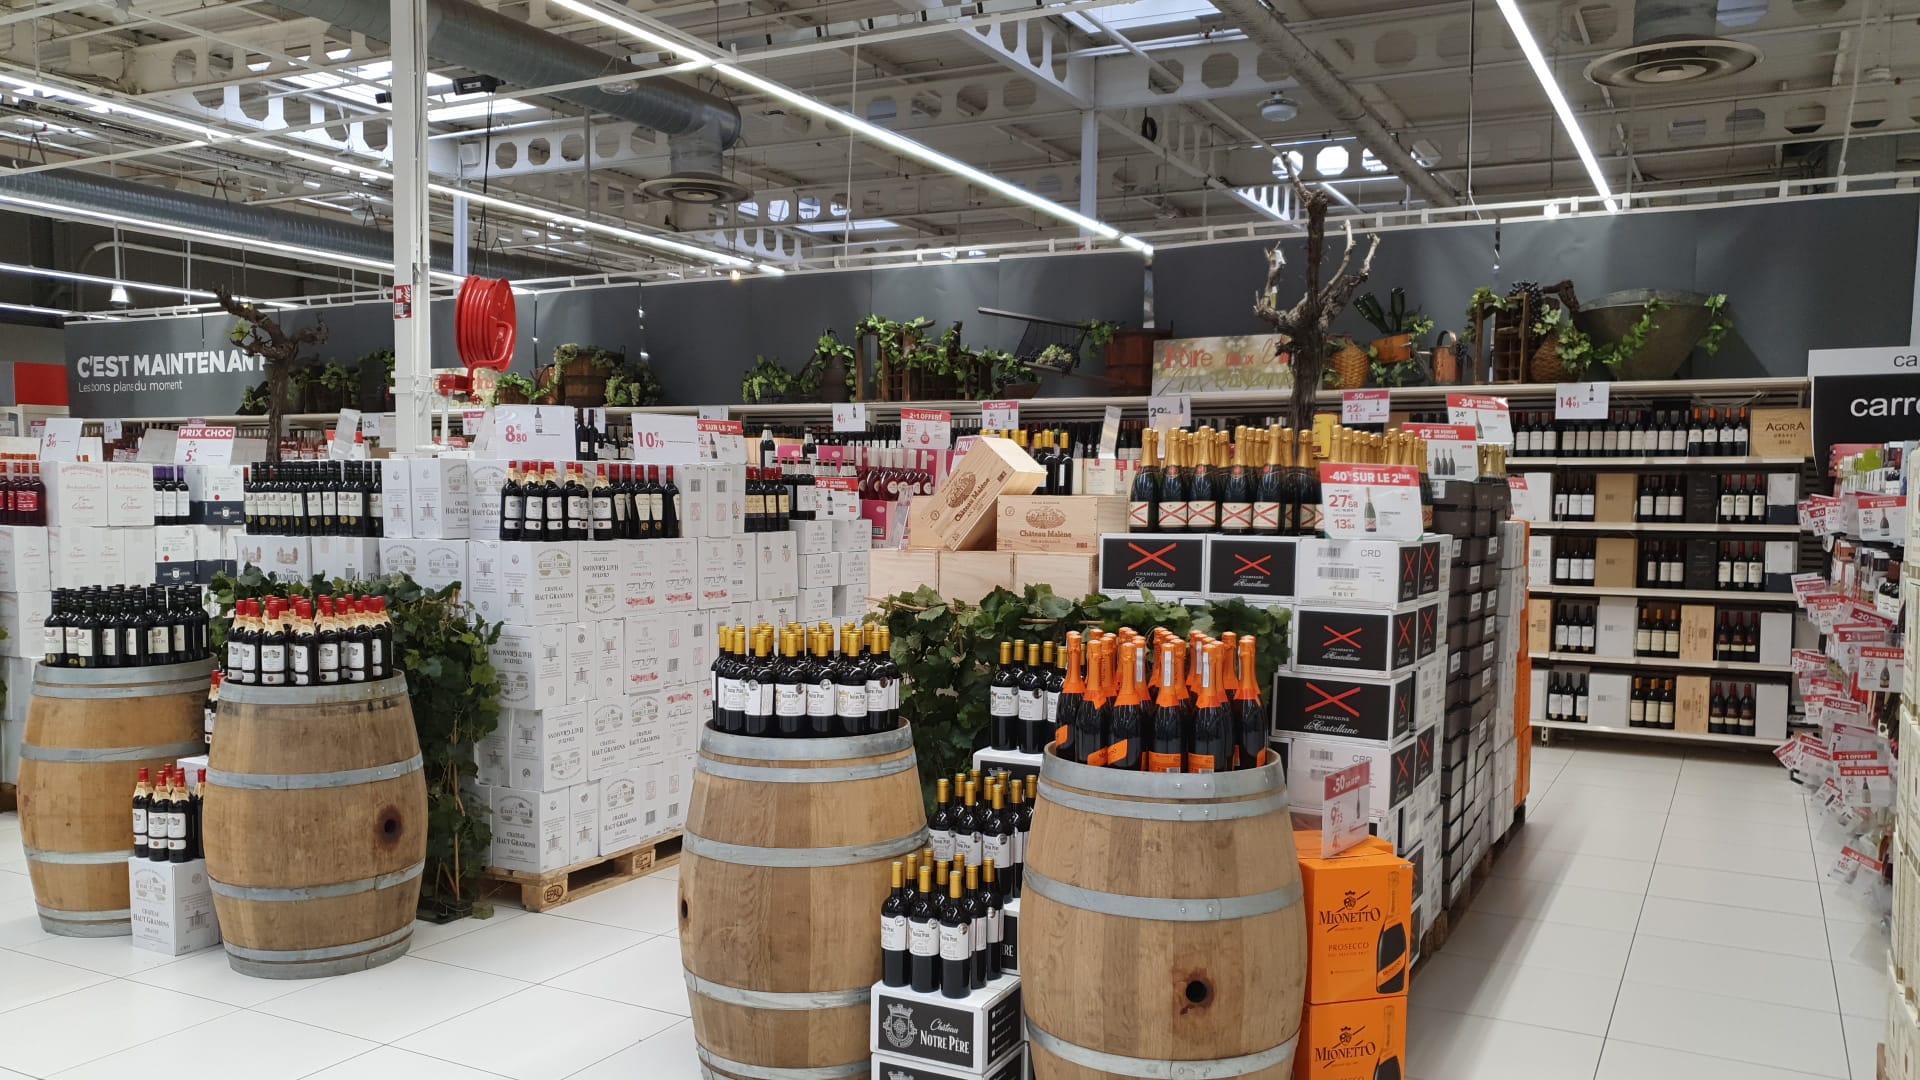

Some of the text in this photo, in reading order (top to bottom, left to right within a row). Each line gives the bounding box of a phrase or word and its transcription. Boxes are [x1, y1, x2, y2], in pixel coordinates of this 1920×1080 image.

[77, 355, 129, 378] C'EST
[78, 382, 90, 392] Les
[113, 381, 134, 393] plans
[134, 380, 146, 391] du
[150, 379, 182, 391] moment
[1850, 396, 1920, 417] carr
[1766, 422, 1806, 431] AGORA
[180, 428, 232, 437] PRIX CHOC
[1353, 472, 1375, 482] SUR
[1378, 473, 1390, 483] LE
[1048, 530, 1072, 538] Malène
[1360, 550, 1381, 558] CRD
[1314, 714, 1350, 722] CHAMPAGNE
[1310, 719, 1360, 735] Castellane
[496, 837, 510, 845] HAUT
[132, 914, 146, 923] HAUT
[1318, 907, 1381, 925] MIONETTO
[1328, 942, 1370, 952] PROSECCO
[930, 1018, 959, 1034] Château
[920, 1030, 970, 1054] NOTRE PÈRE
[1314, 1042, 1376, 1062] MIONETTO
